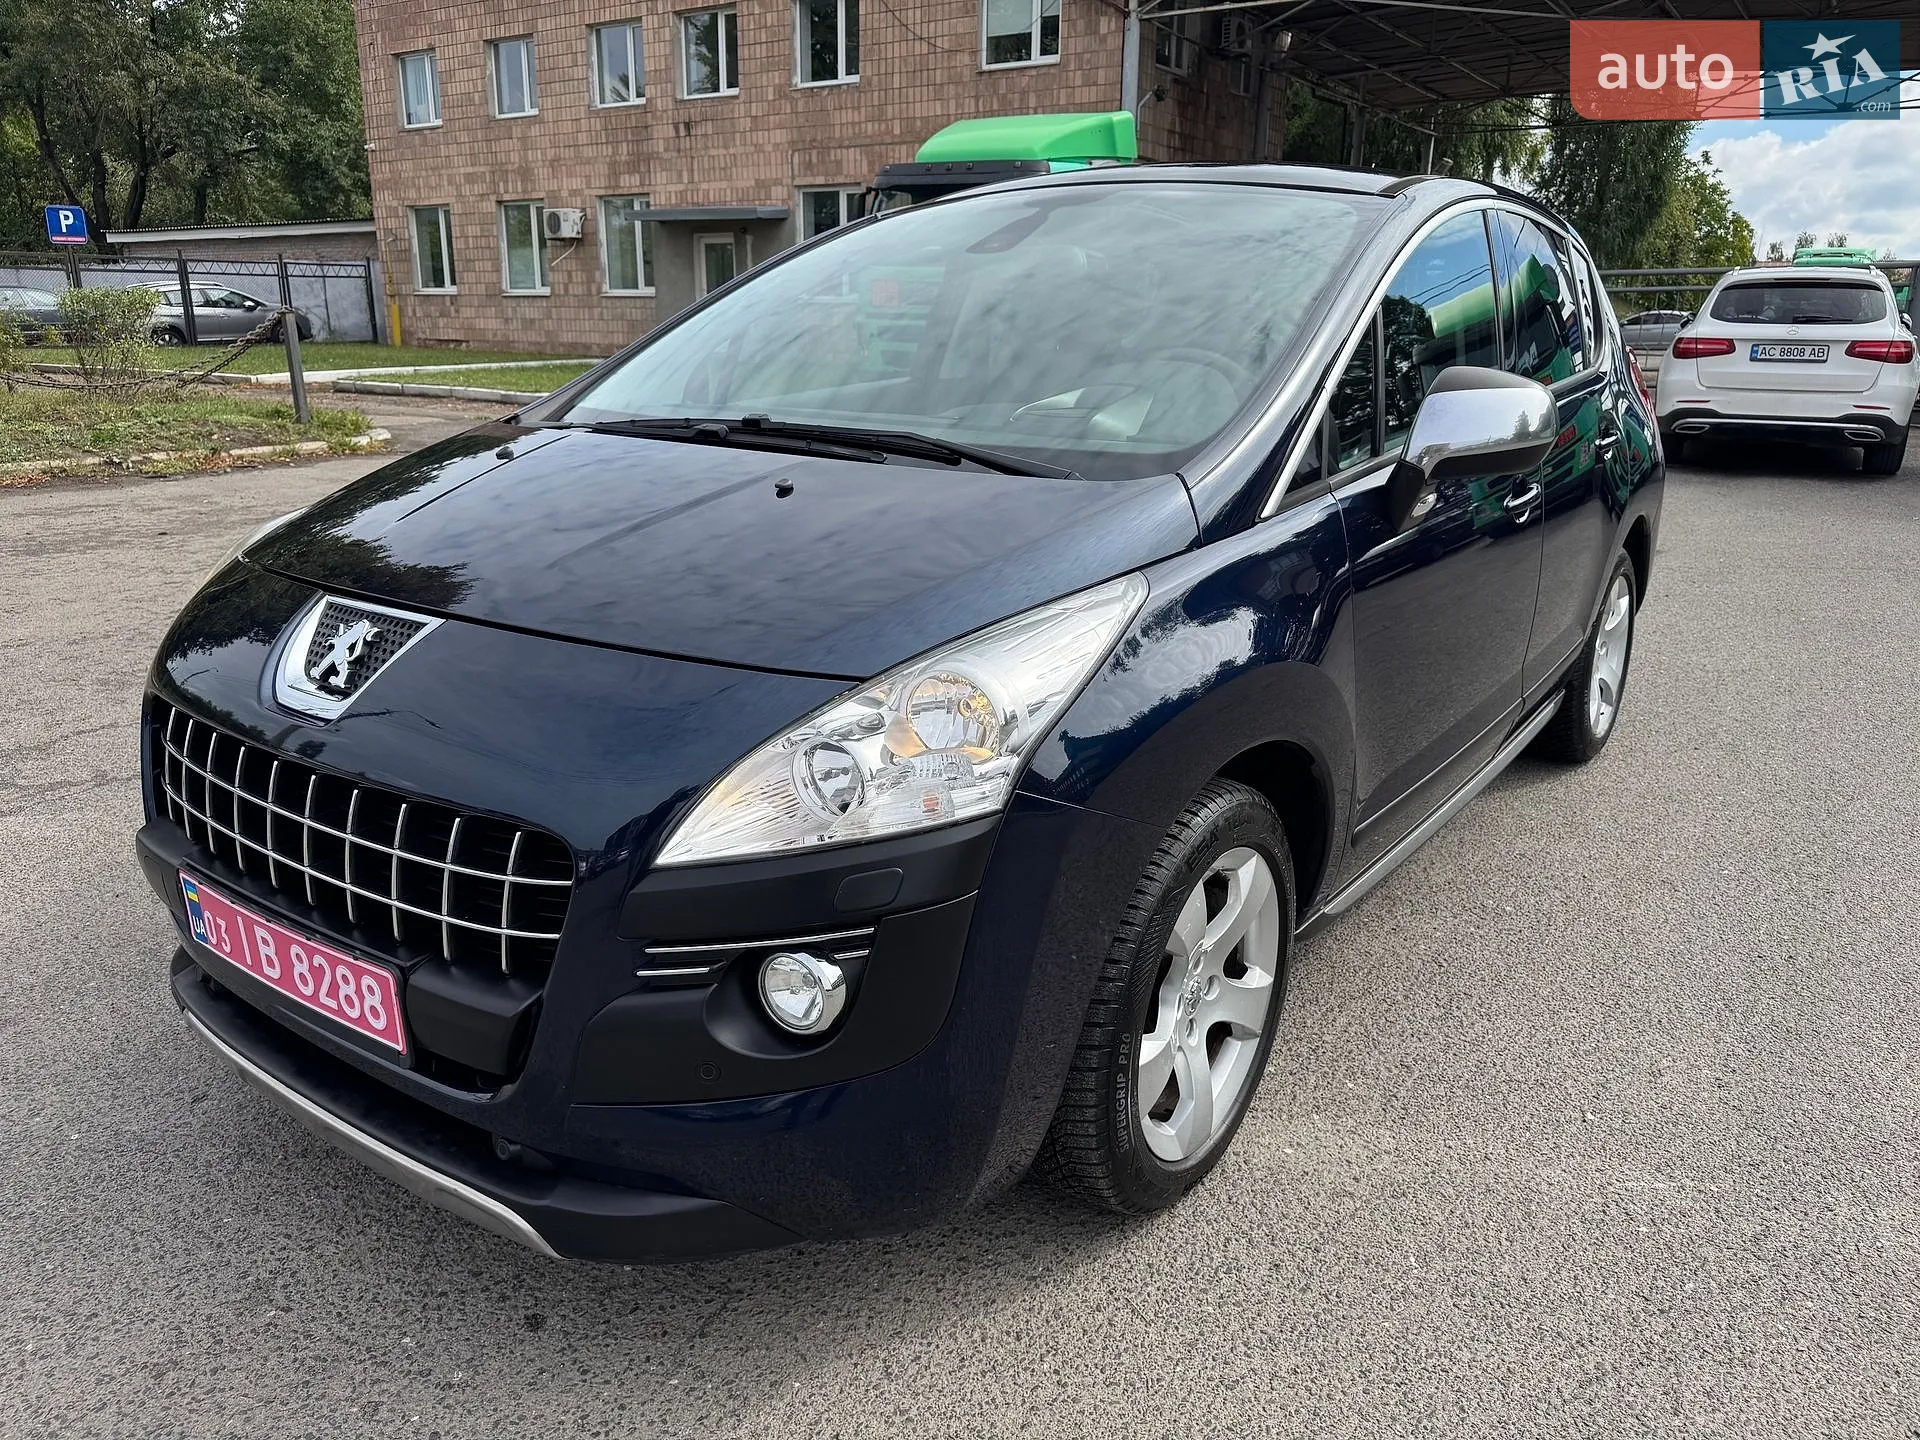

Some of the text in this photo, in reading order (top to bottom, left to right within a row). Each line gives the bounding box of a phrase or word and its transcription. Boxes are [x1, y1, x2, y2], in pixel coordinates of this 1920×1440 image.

[58, 210, 74, 233] P
[1759, 346, 1776, 357] AC
[1779, 347, 1806, 357] 8808
[1808, 347, 1826, 358] AB
[192, 915, 208, 938] UA
[203, 910, 232, 954] 03
[289, 944, 388, 1031] 8288
[1116, 1033, 1132, 1153] SUPERGRIP PRO
